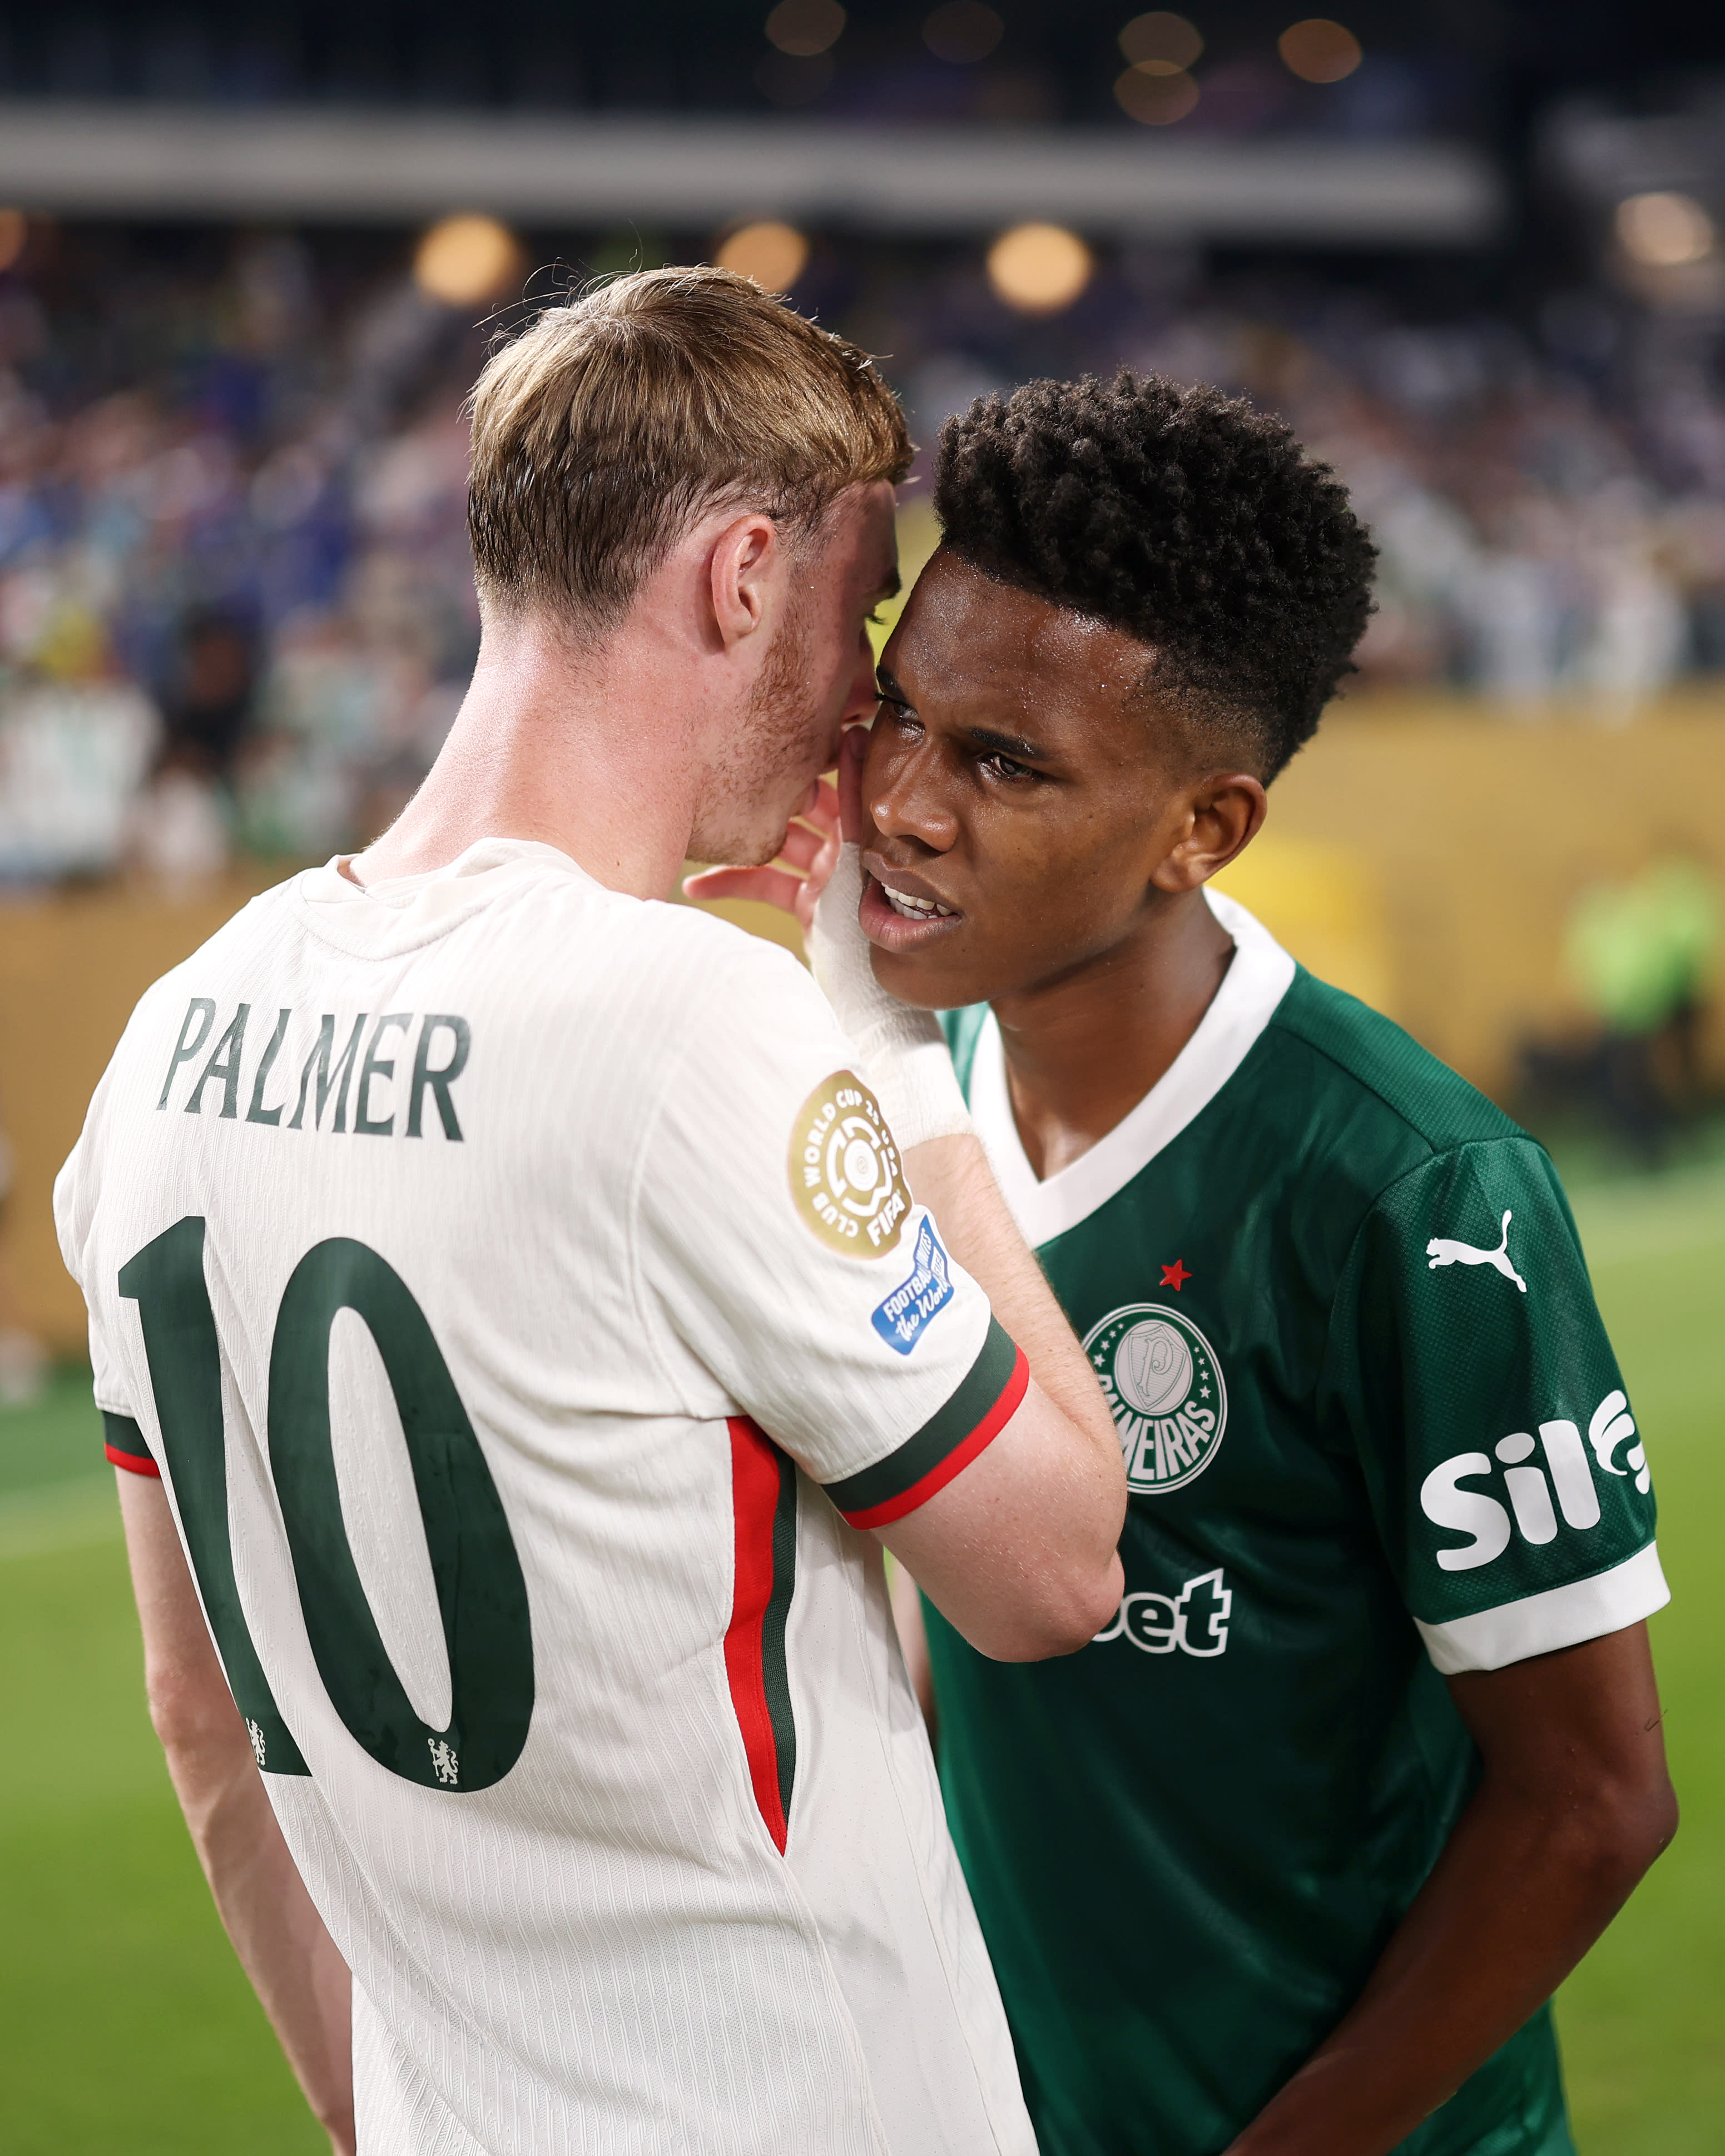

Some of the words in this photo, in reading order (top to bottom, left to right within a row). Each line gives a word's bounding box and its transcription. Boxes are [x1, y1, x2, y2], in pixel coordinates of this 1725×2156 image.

[156, 997, 471, 1143] PALMER
[836, 1088, 863, 1109] CUP
[803, 1102, 836, 1188] WORLD
[812, 1191, 859, 1238] CLUB
[866, 1191, 906, 1247] FIFA
[895, 1313, 920, 1342] the
[1097, 1373, 1216, 1481] PMEIRAS
[117, 1216, 536, 1793] 10
